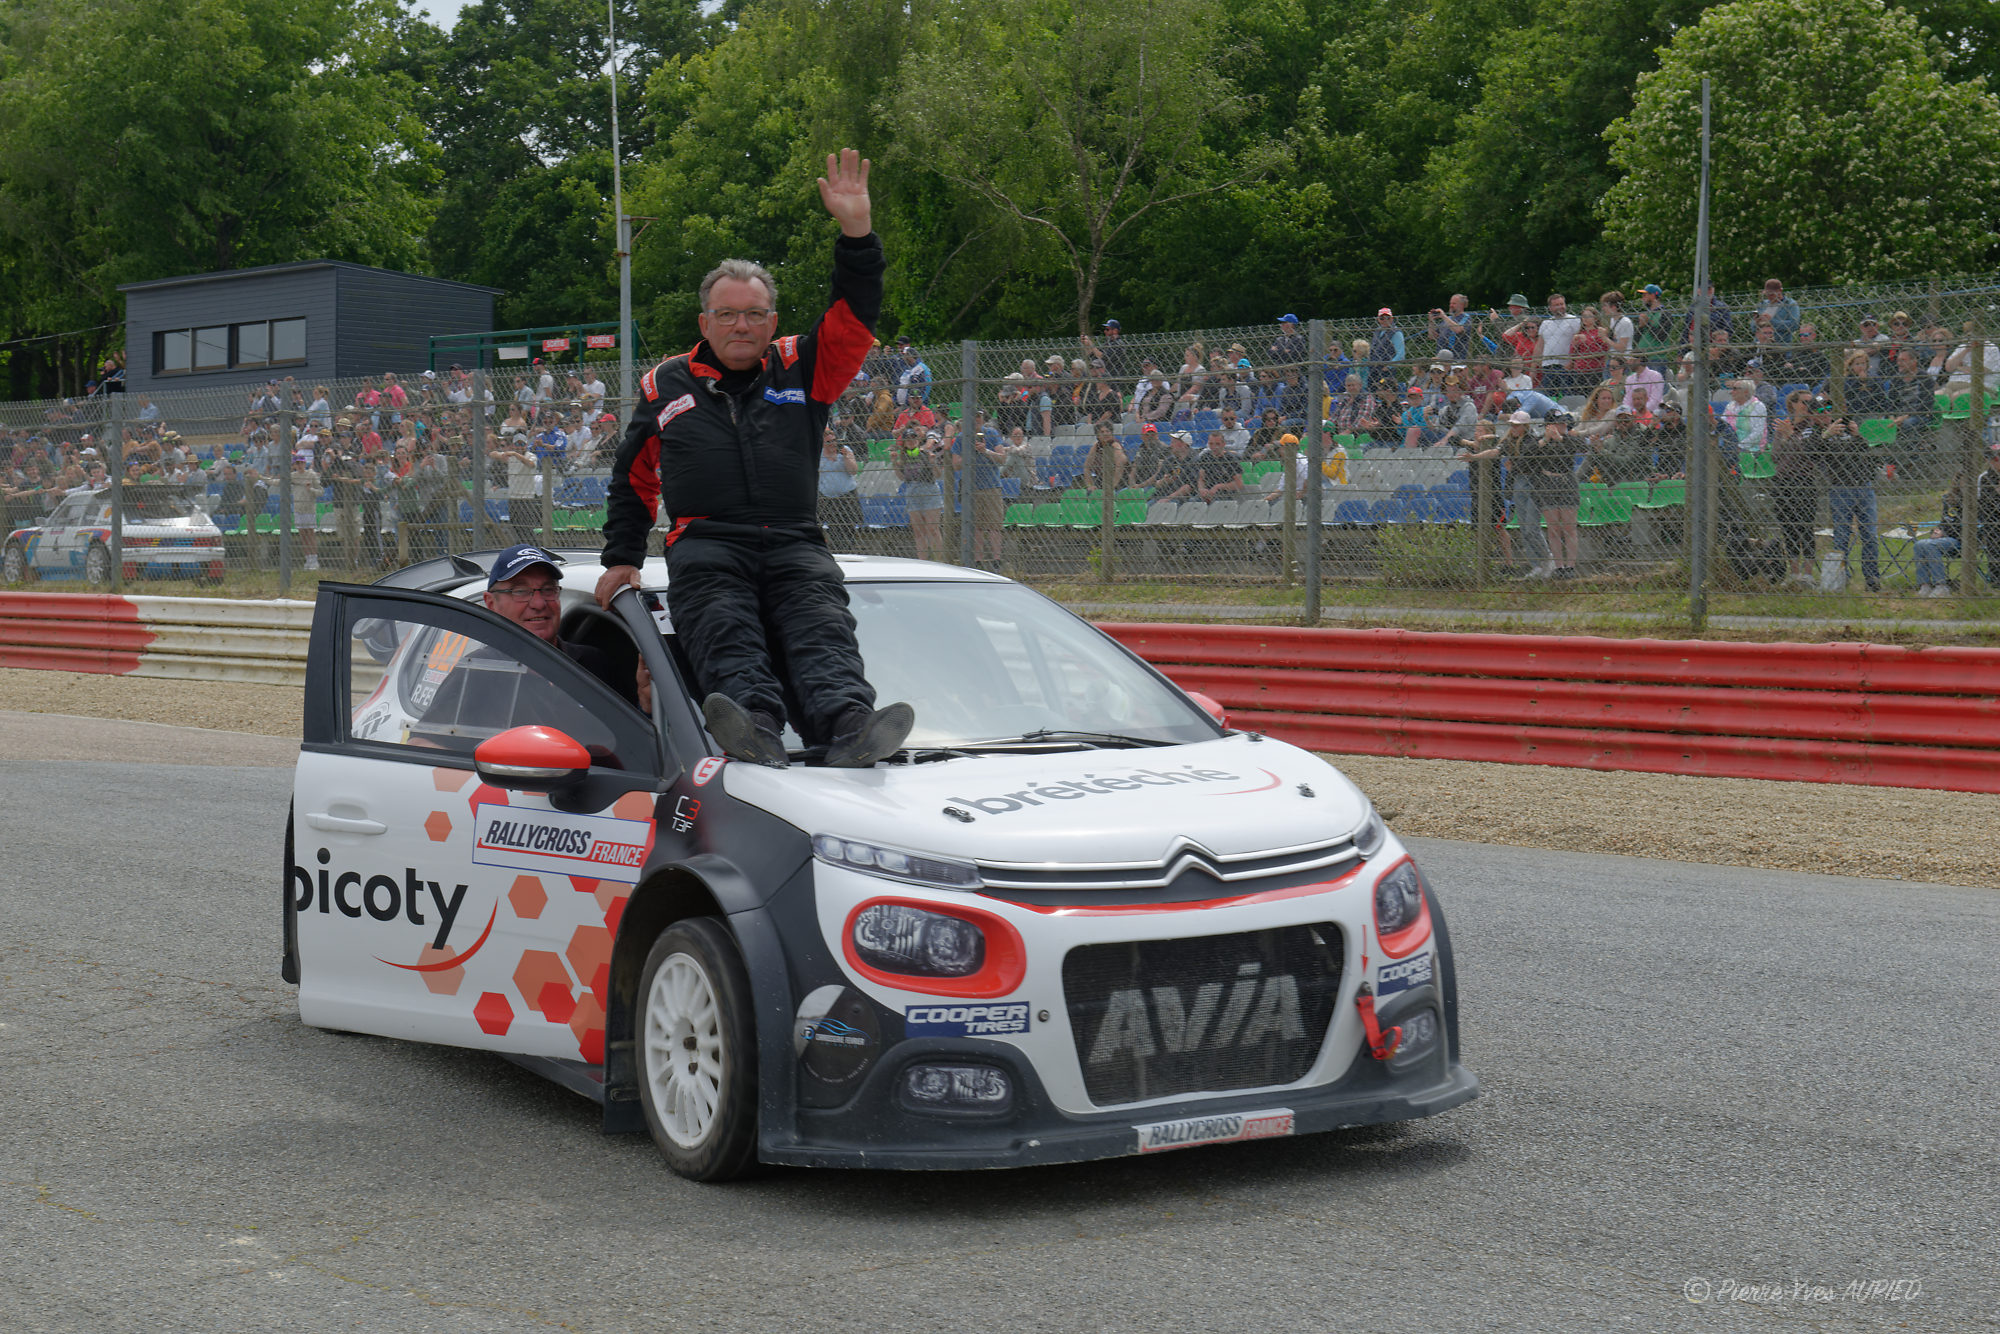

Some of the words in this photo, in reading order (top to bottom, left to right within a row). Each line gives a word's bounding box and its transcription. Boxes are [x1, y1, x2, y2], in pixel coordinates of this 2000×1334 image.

[485, 820, 592, 855] RALLYCROSS
[590, 842, 645, 866] FRANCE
[1380, 955, 1432, 983] COOPER
[907, 1005, 1028, 1024] COOPER
[964, 1020, 1026, 1033] TIRES
[1147, 1115, 1243, 1146] RALLYCROSS
[1243, 1116, 1291, 1139] FRANCE
